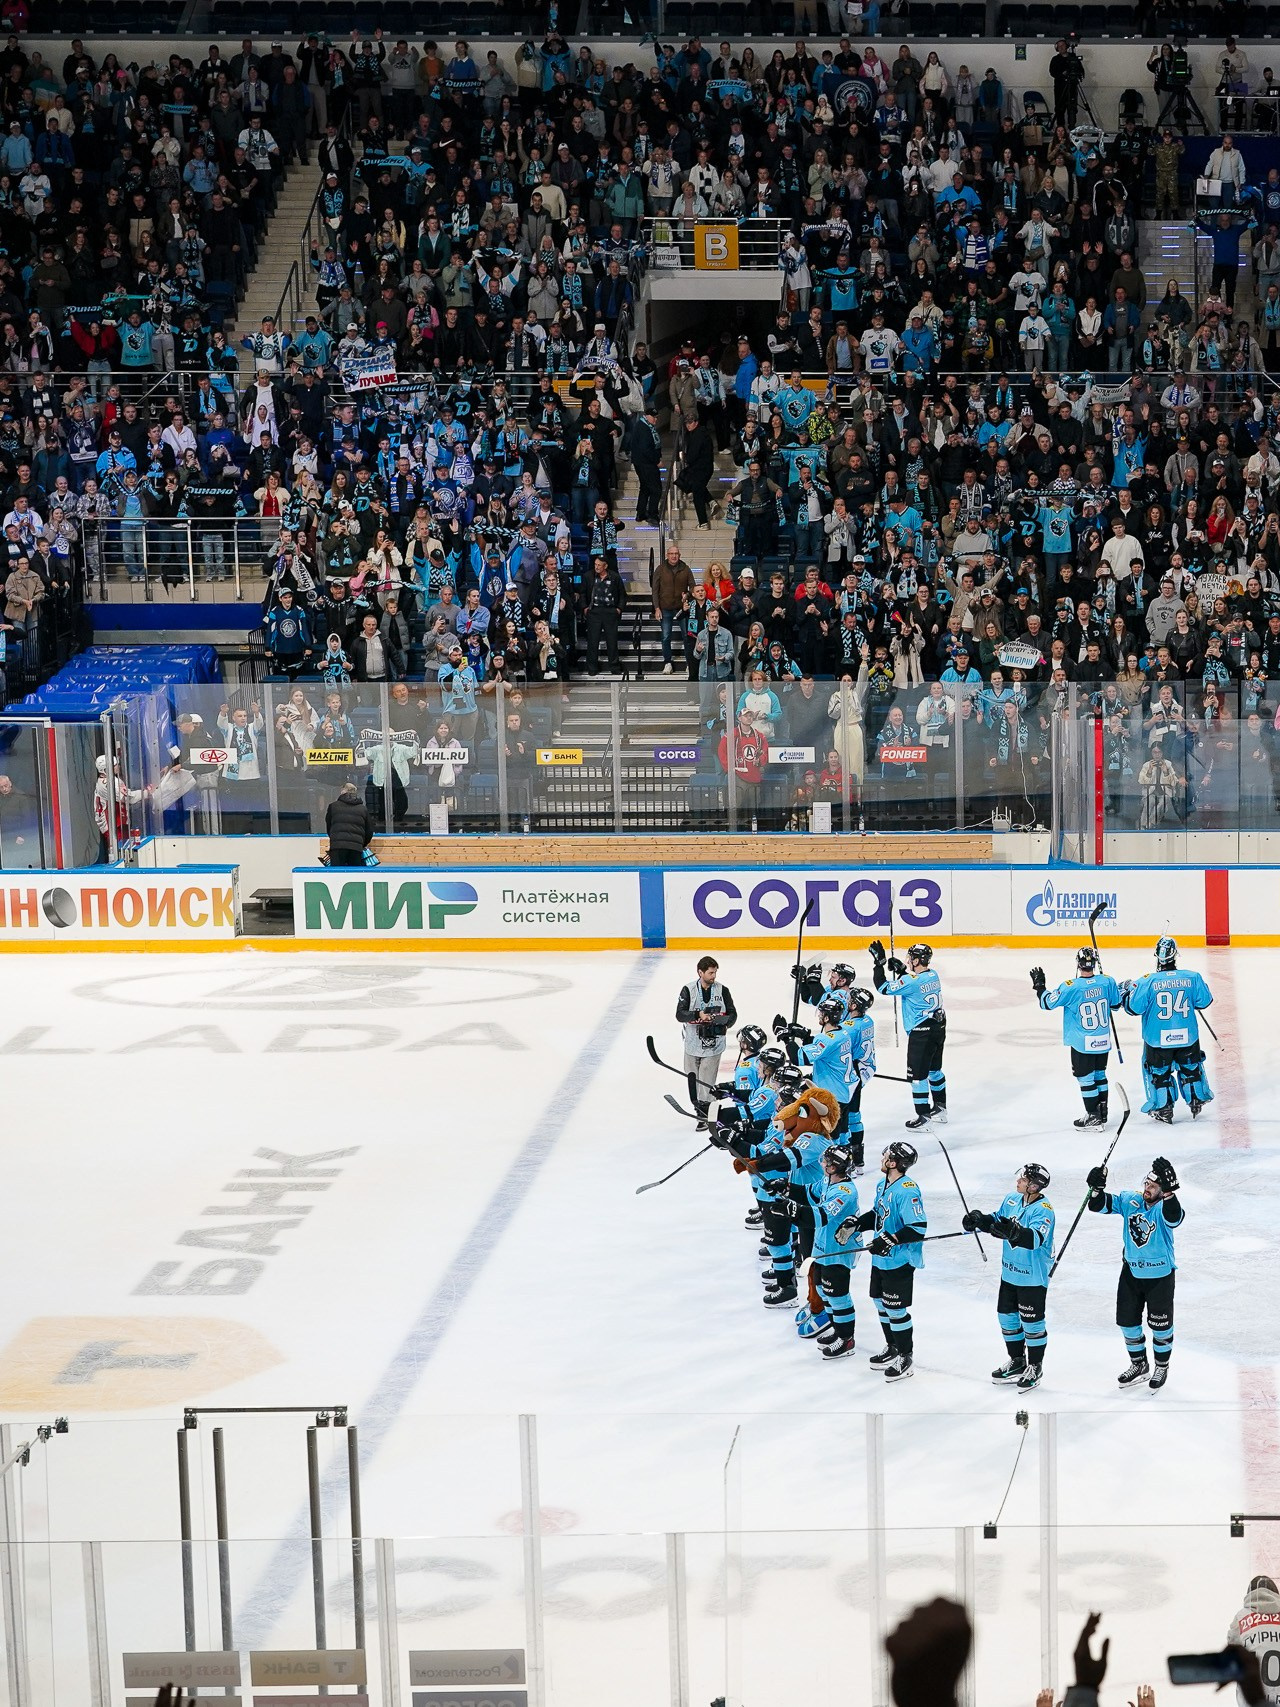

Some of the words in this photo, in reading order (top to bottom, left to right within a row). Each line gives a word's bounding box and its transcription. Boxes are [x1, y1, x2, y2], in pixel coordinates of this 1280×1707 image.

[308, 752, 328, 760] MAX
[329, 754, 350, 762] LINE
[424, 751, 467, 761] KHL.RU
[658, 750, 696, 760] согаз
[881, 750, 926, 760] FONBET
[503, 889, 609, 904] Платёжная
[1057, 892, 1117, 908] ГАЗПРОМ
[304, 882, 479, 930] МИР
[692, 878, 943, 929] согаз
[503, 911, 581, 923] система
[1153, 979, 1192, 991] DEMCHENKO
[1085, 988, 1103, 999] USOV
[1156, 989, 1190, 1020] 94
[1079, 998, 1109, 1031] 80
[0, 1022, 531, 1055] LADA
